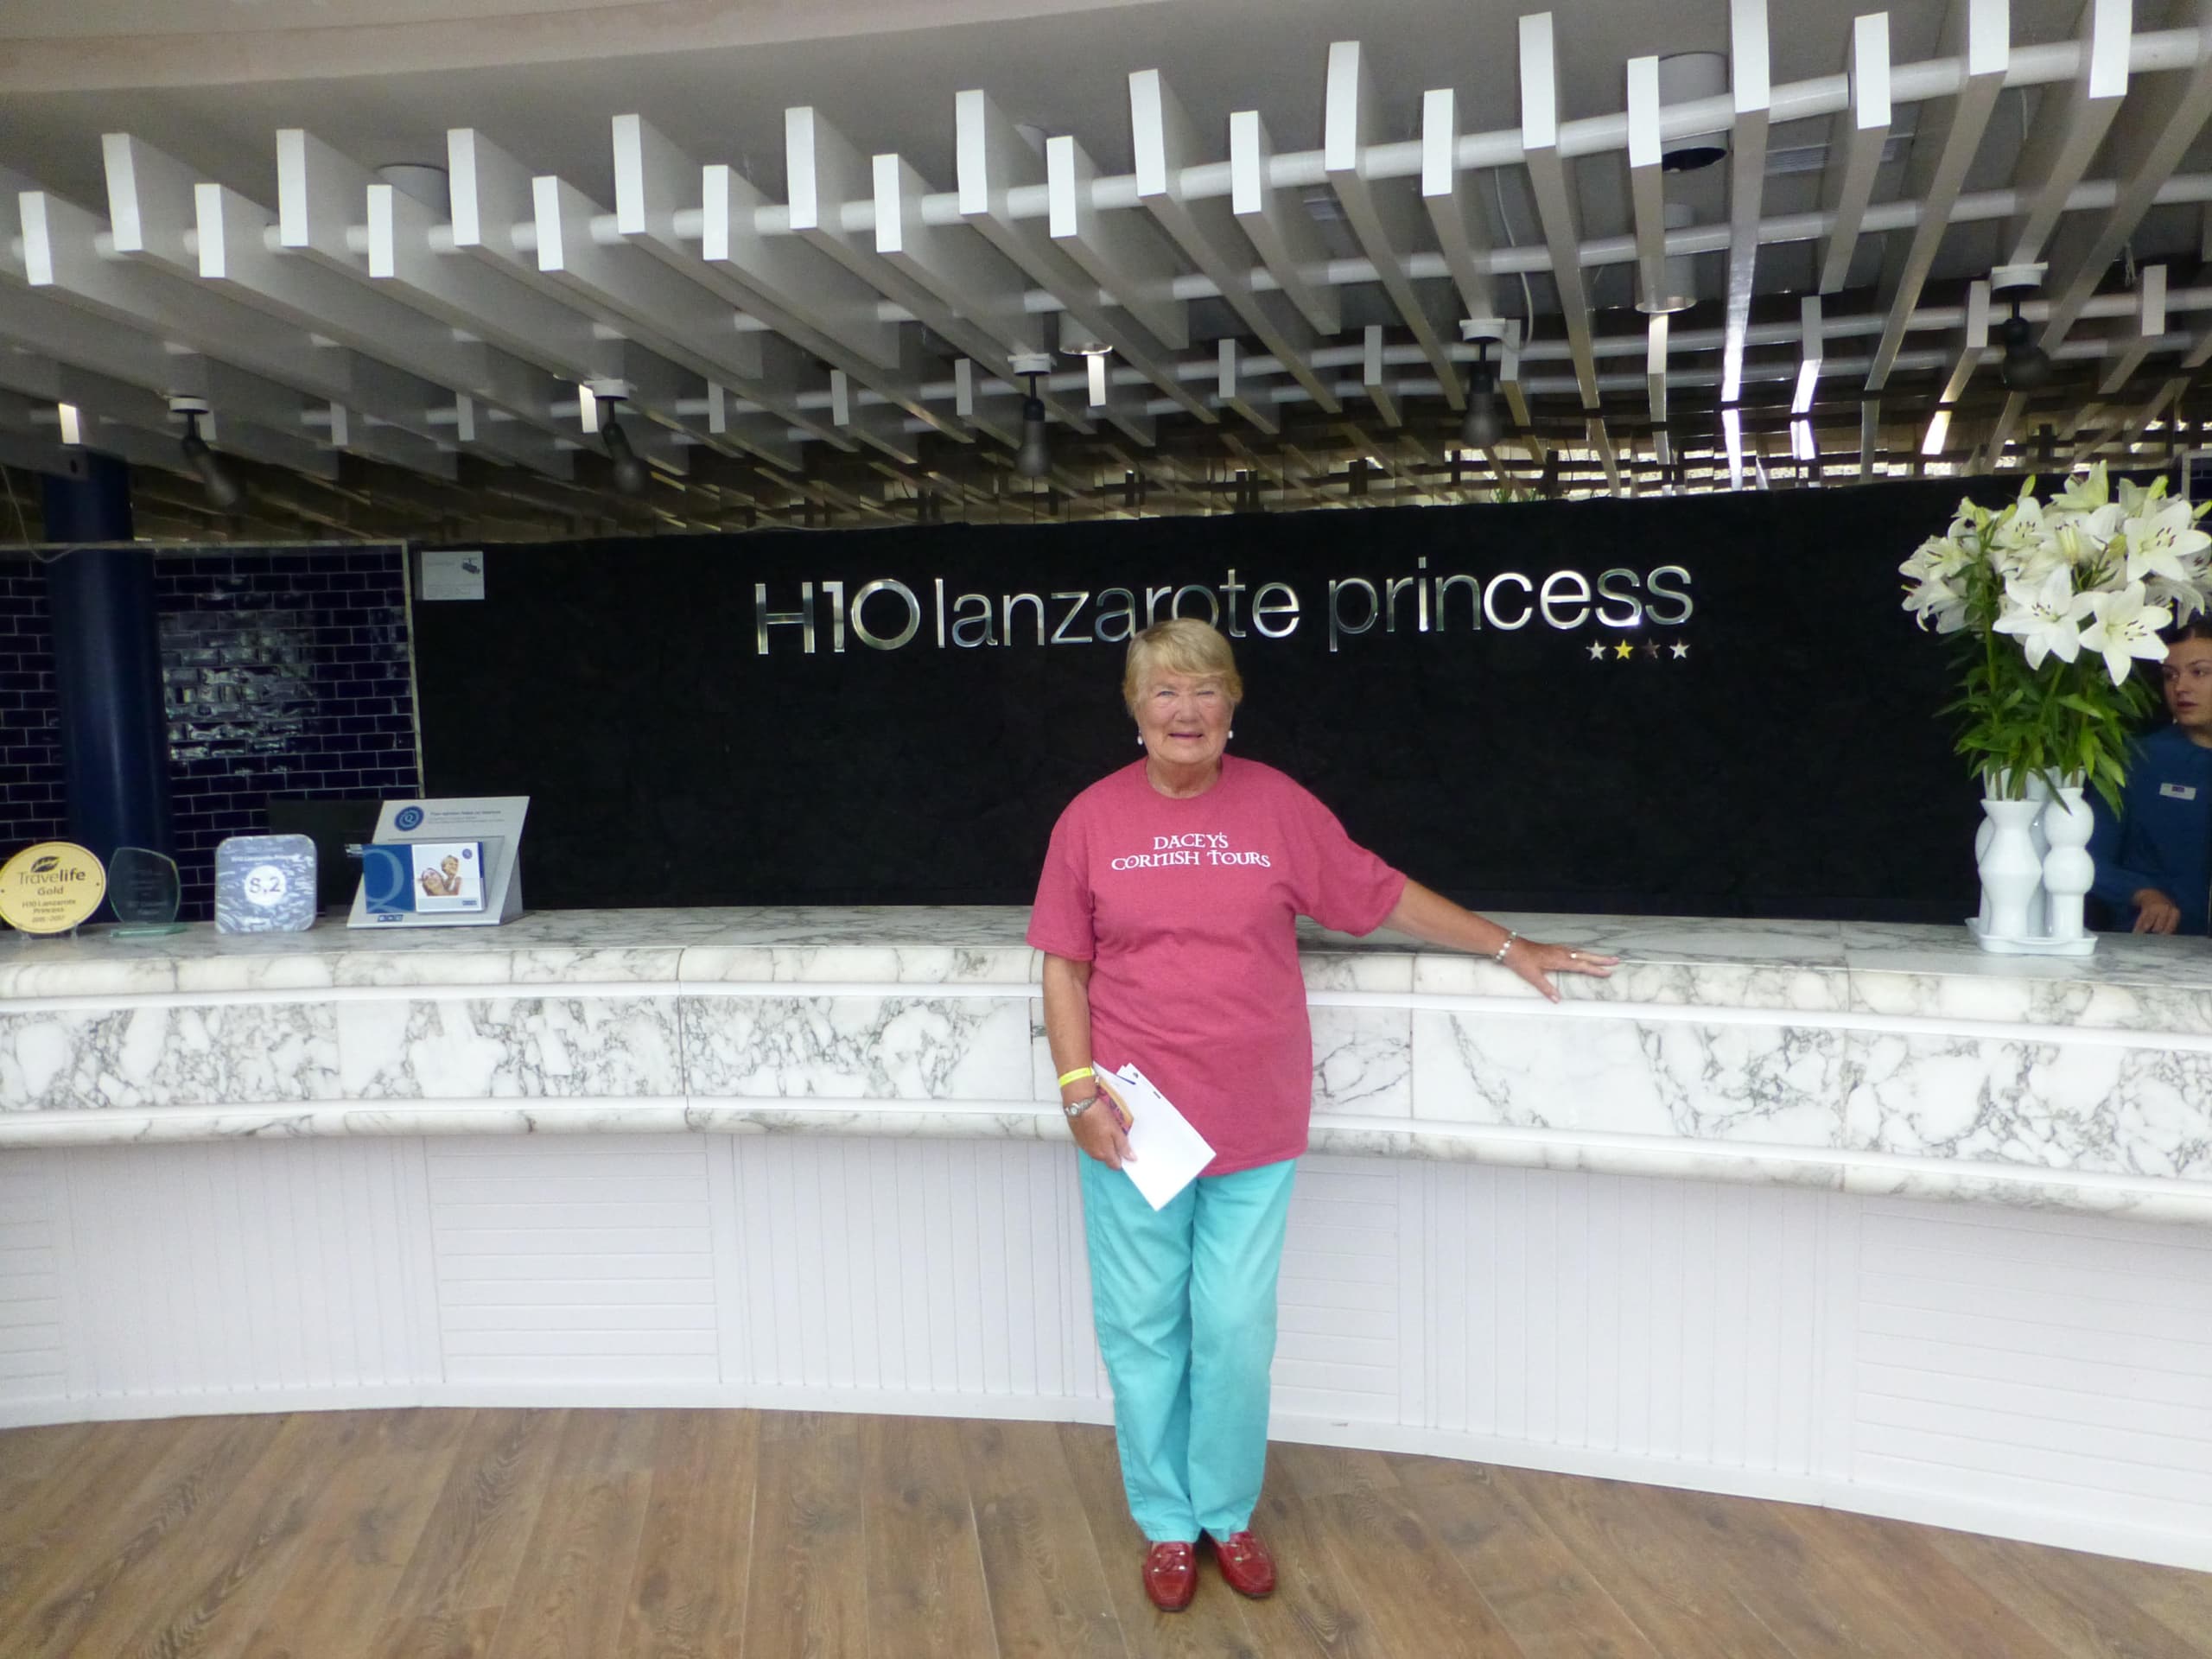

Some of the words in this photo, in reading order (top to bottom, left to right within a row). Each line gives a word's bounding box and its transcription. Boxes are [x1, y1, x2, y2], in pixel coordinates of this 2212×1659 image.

[755, 578, 920, 654] H10
[935, 569, 1300, 649] lanzarote
[1328, 556, 1694, 652] princess
[1111, 850, 1200, 871] CORNISH
[1207, 849, 1271, 868] TOURS
[16, 868, 86, 885] Travelife
[249, 877, 282, 893] 8.2
[37, 887, 64, 896] Gold
